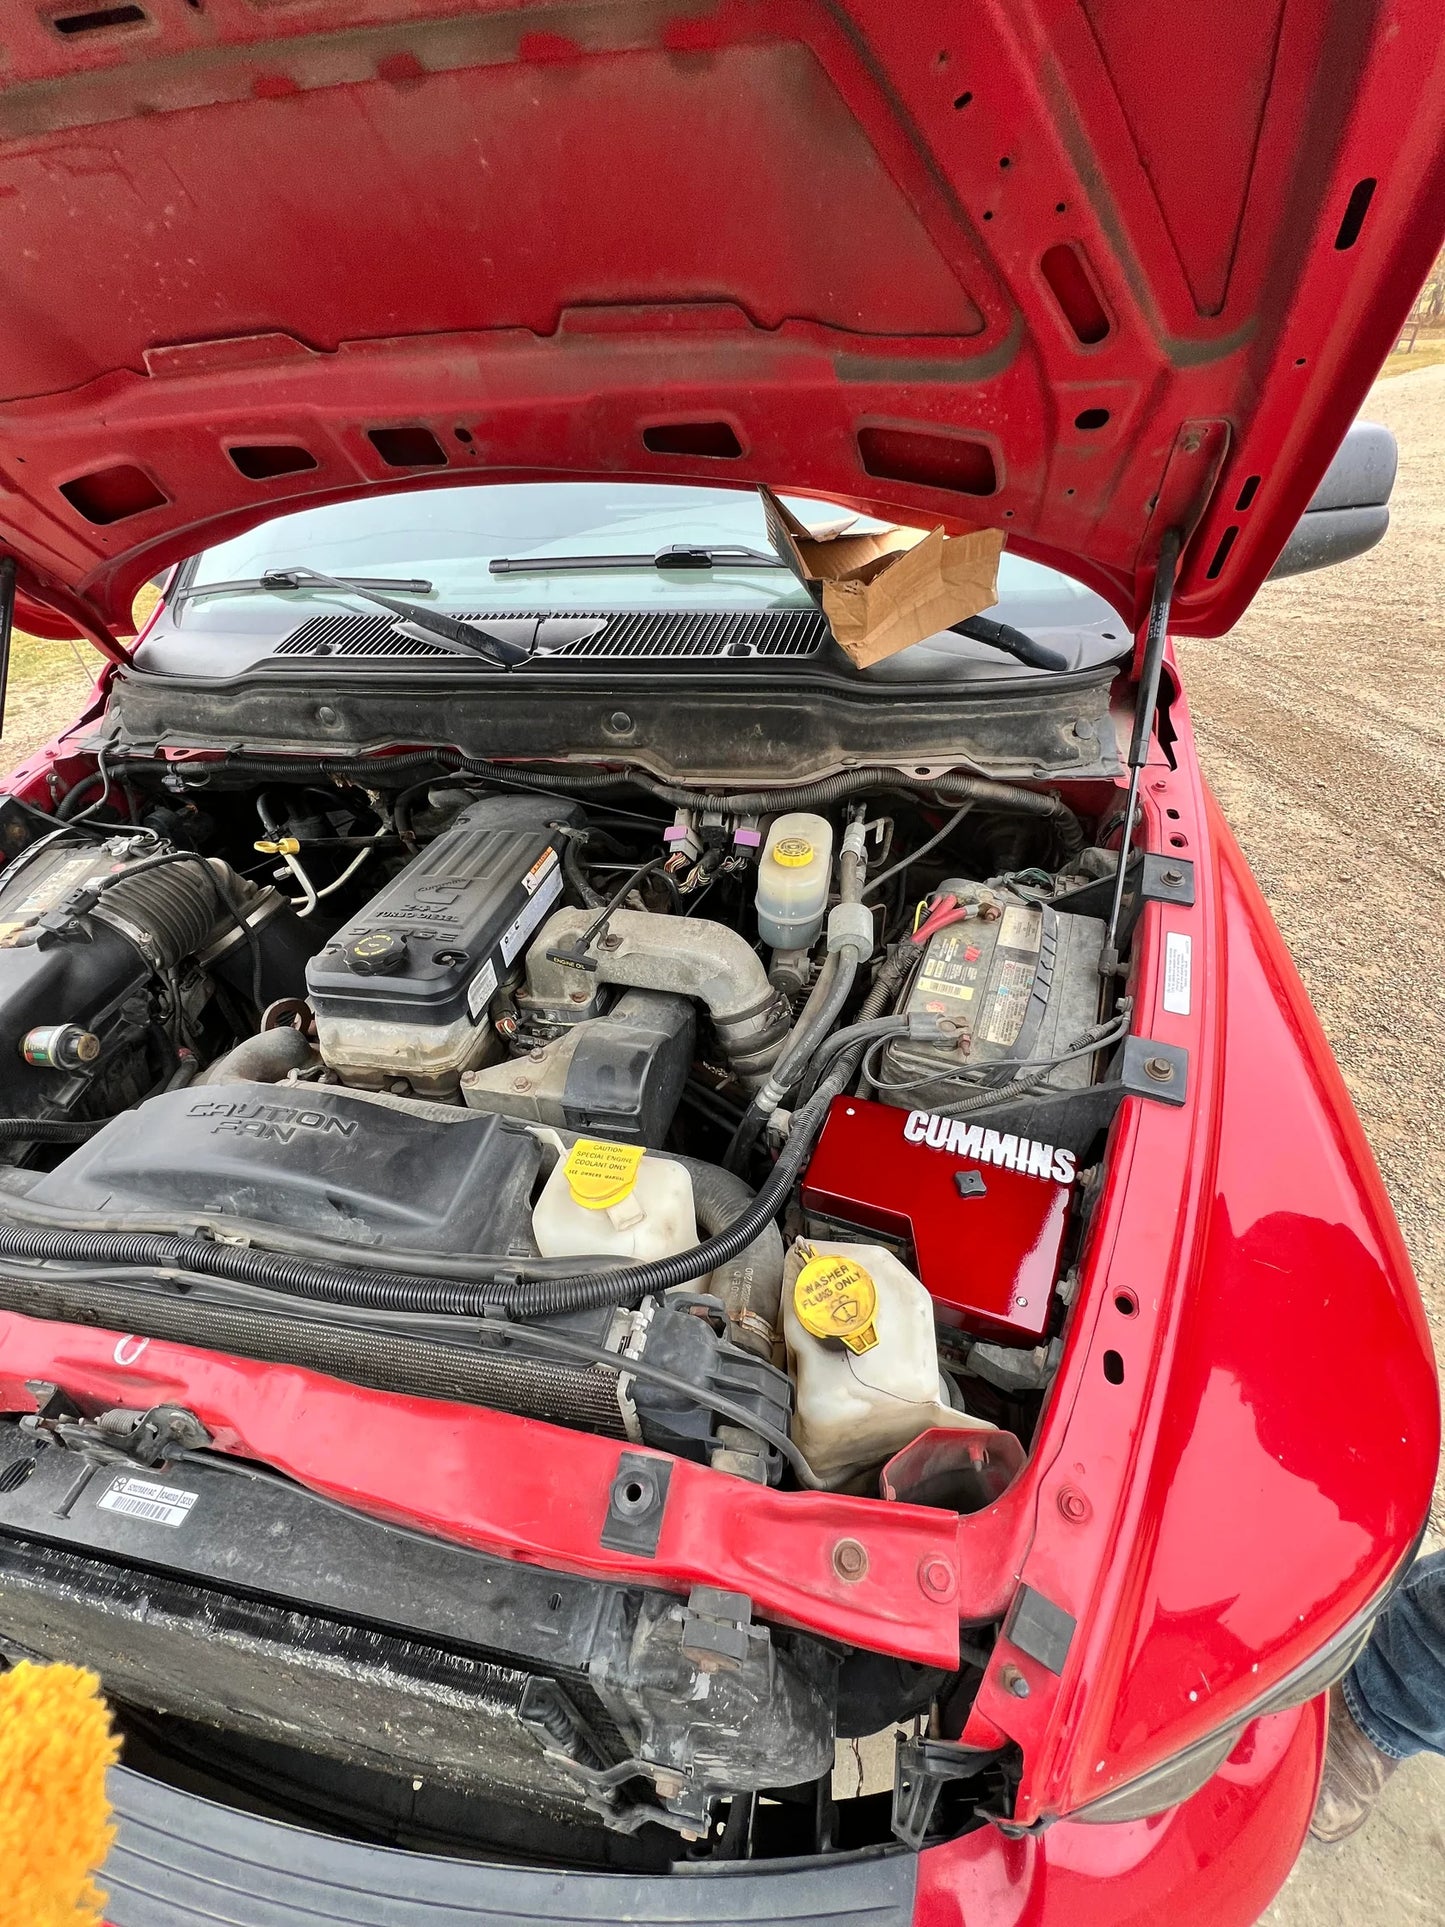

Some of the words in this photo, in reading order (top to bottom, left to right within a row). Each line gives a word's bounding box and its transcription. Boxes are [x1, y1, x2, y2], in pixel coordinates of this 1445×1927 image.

[375, 911, 415, 919] TURBO
[417, 912, 460, 922] DIESEL
[553, 957, 575, 968] ENGINE
[186, 1102, 359, 1137] CAUTION
[210, 1119, 297, 1144] FAN
[593, 1144, 624, 1153] CAUTION
[903, 1109, 1077, 1184] CUMMINS
[574, 1158, 607, 1168] COOLANT
[608, 1163, 627, 1171] ONLY
[576, 1150, 604, 1160] SPECIAL
[606, 1154, 633, 1164] ENGINE
[804, 1264, 850, 1294] WASHER
[834, 1271, 861, 1291] ONLY
